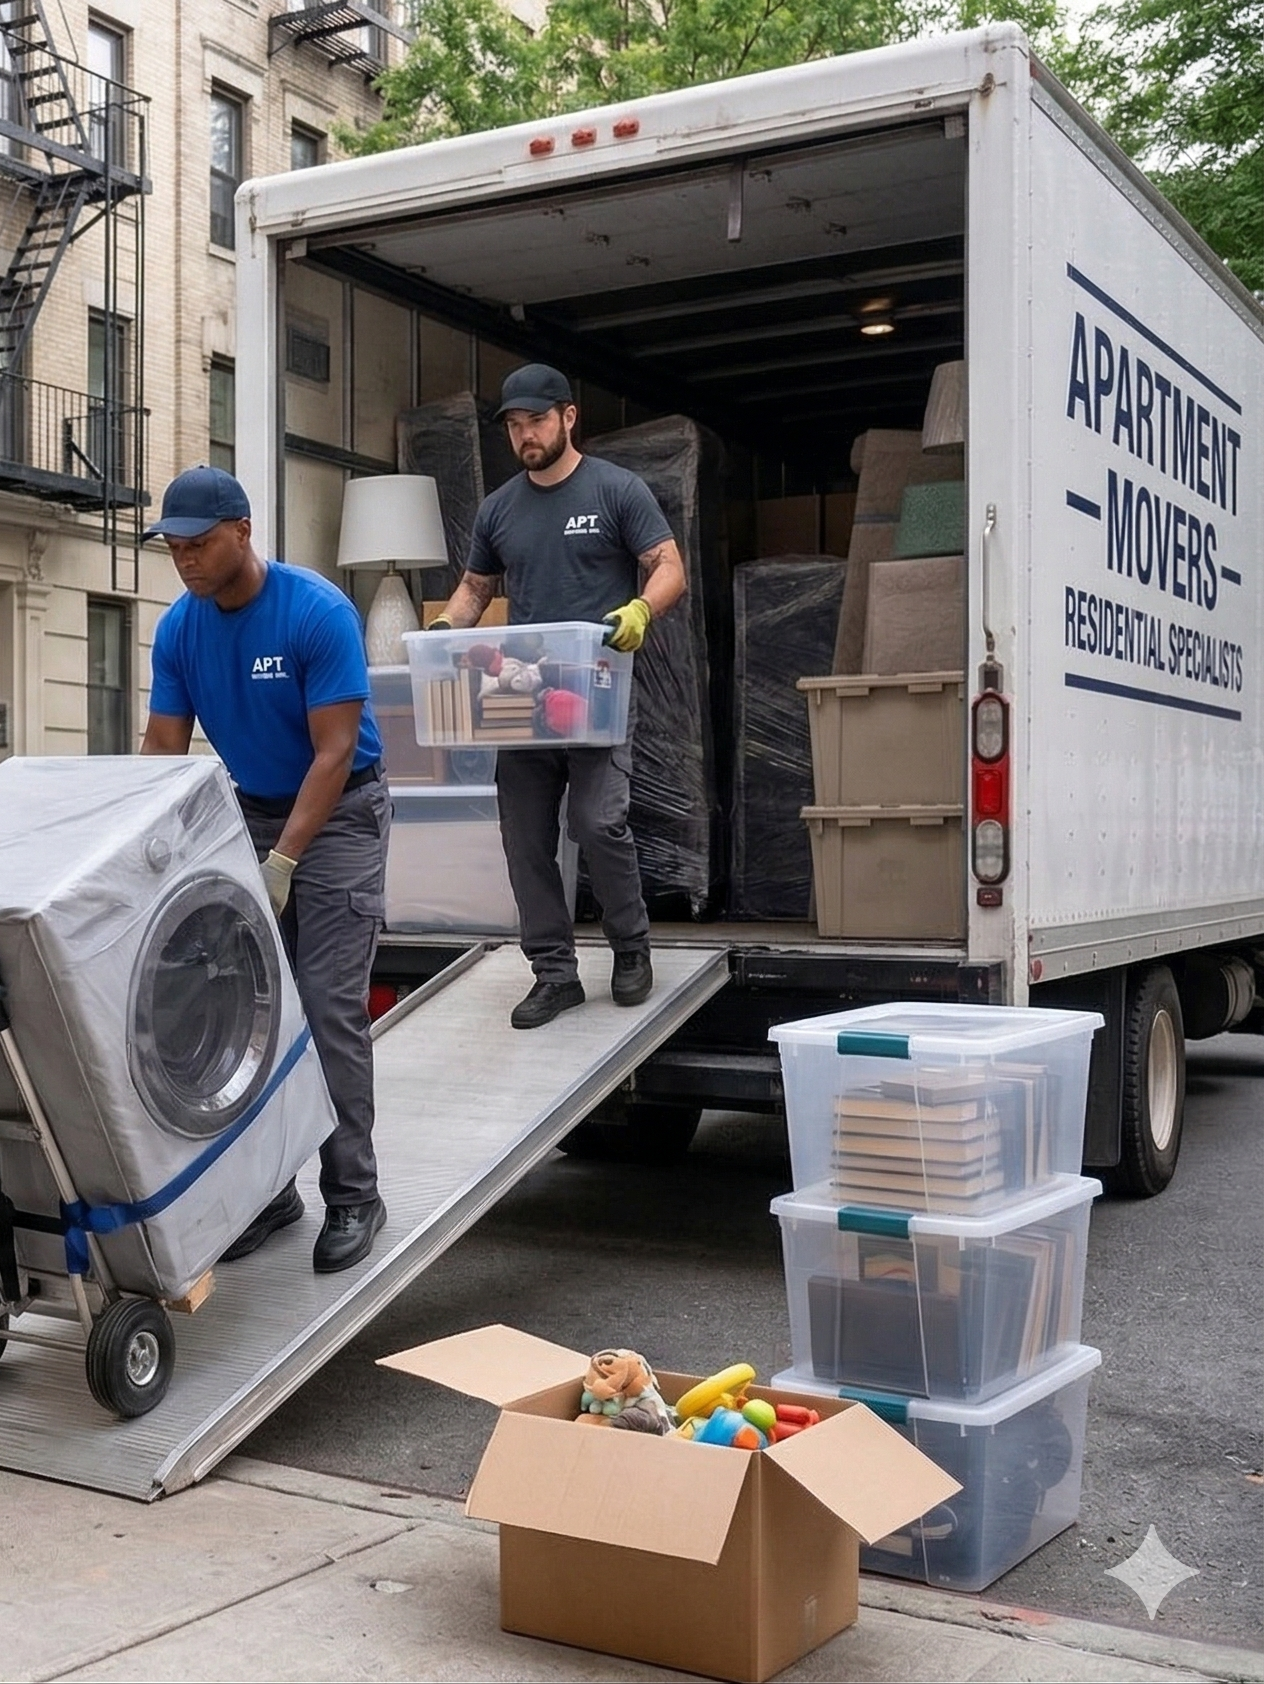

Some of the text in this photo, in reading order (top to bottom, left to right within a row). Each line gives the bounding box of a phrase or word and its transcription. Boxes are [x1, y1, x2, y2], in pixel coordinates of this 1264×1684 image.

[1066, 311, 1242, 516] APARTMENT
[565, 514, 598, 529] APT
[1106, 467, 1218, 611] MOVERS
[252, 656, 283, 672] APT
[1064, 585, 1243, 693] RESIDENTIAL SPECIALISTS
